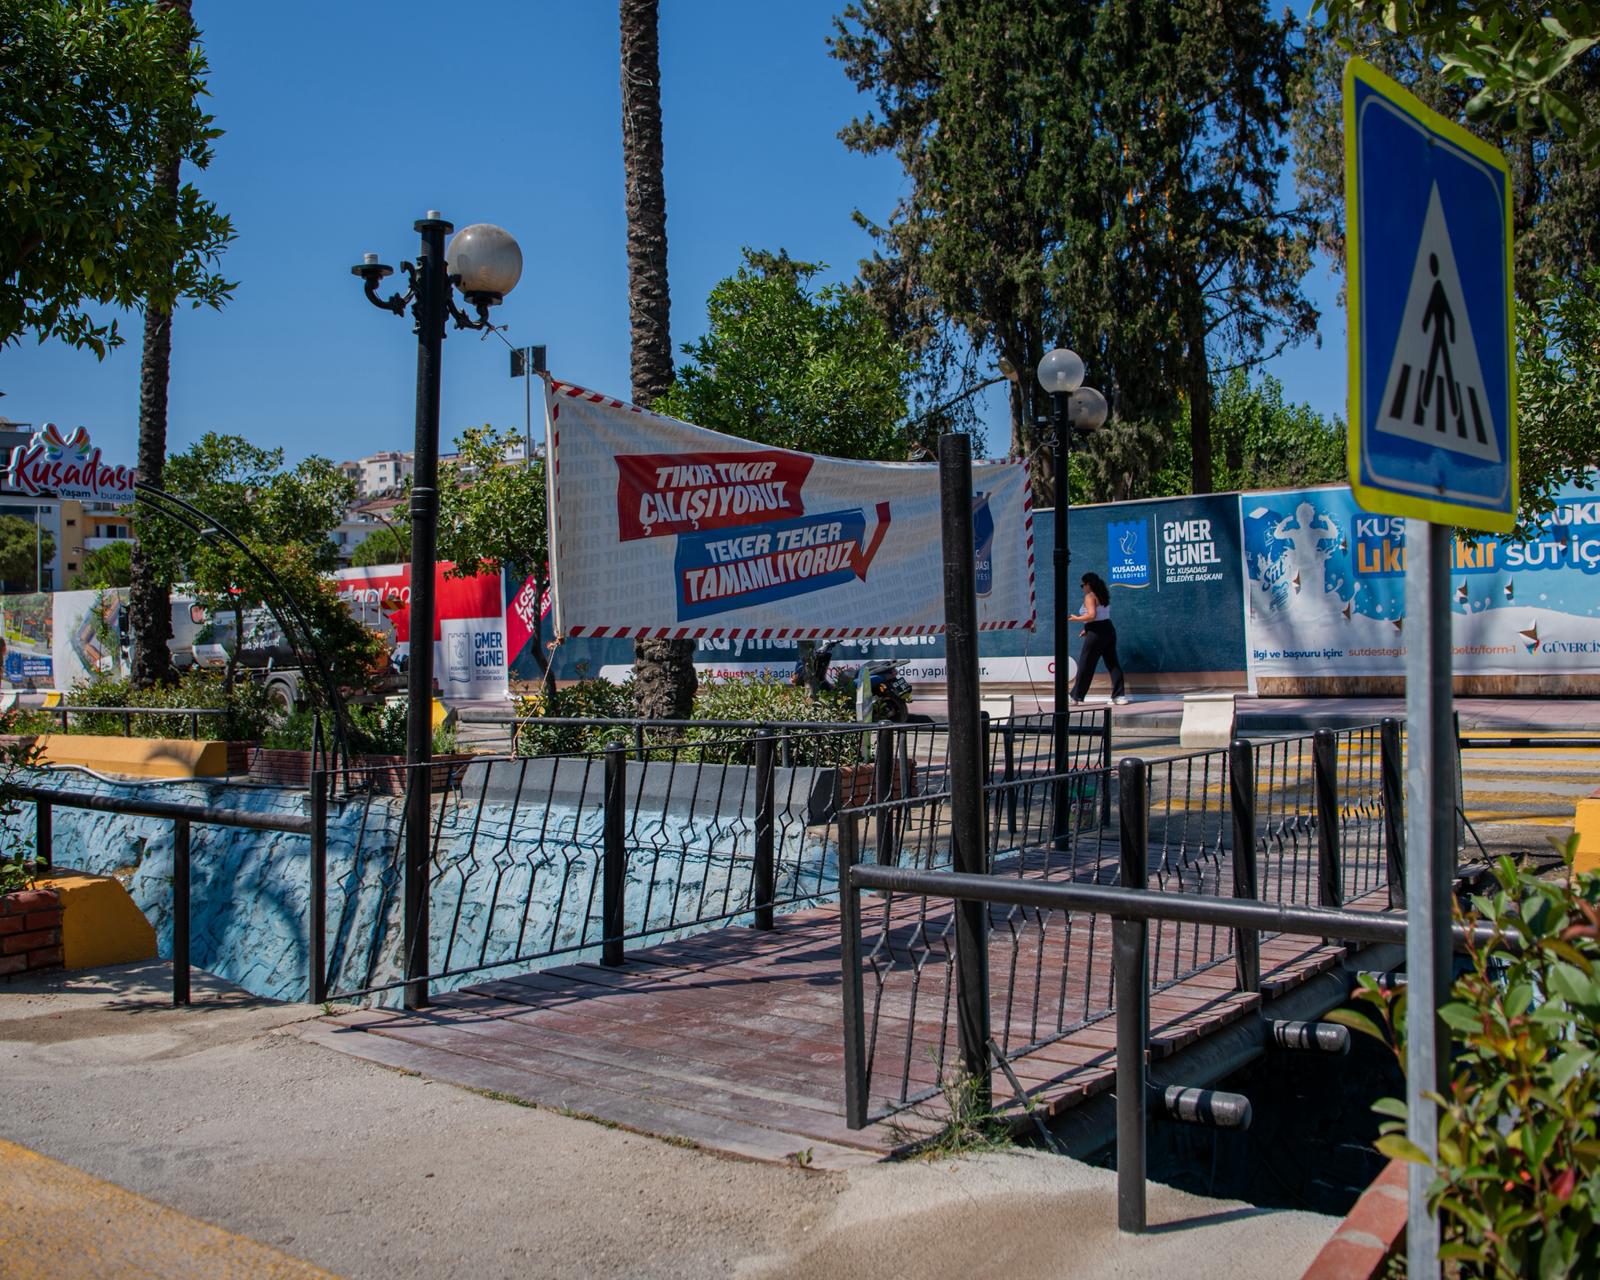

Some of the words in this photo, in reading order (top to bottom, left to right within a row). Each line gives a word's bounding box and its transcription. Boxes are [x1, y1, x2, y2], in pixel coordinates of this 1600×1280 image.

[655, 464, 717, 489] TIKIR
[717, 461, 777, 483] TIKIR
[639, 481, 792, 536] ÇALIŞIYORUZ
[705, 536, 771, 564] TEKER
[776, 522, 842, 551] TEKER
[1163, 519, 1212, 544] ÖMER
[1357, 517, 1405, 541] KUŞ
[1164, 541, 1221, 566] GÜNEL
[1506, 535, 1560, 566] SÜT
[685, 540, 857, 602] TAMAMLIYORUZ
[514, 583, 535, 616] LGS
[474, 632, 503, 649] ÖMER
[1282, 649, 1321, 660] başvuru
[1322, 648, 1344, 660] için:
